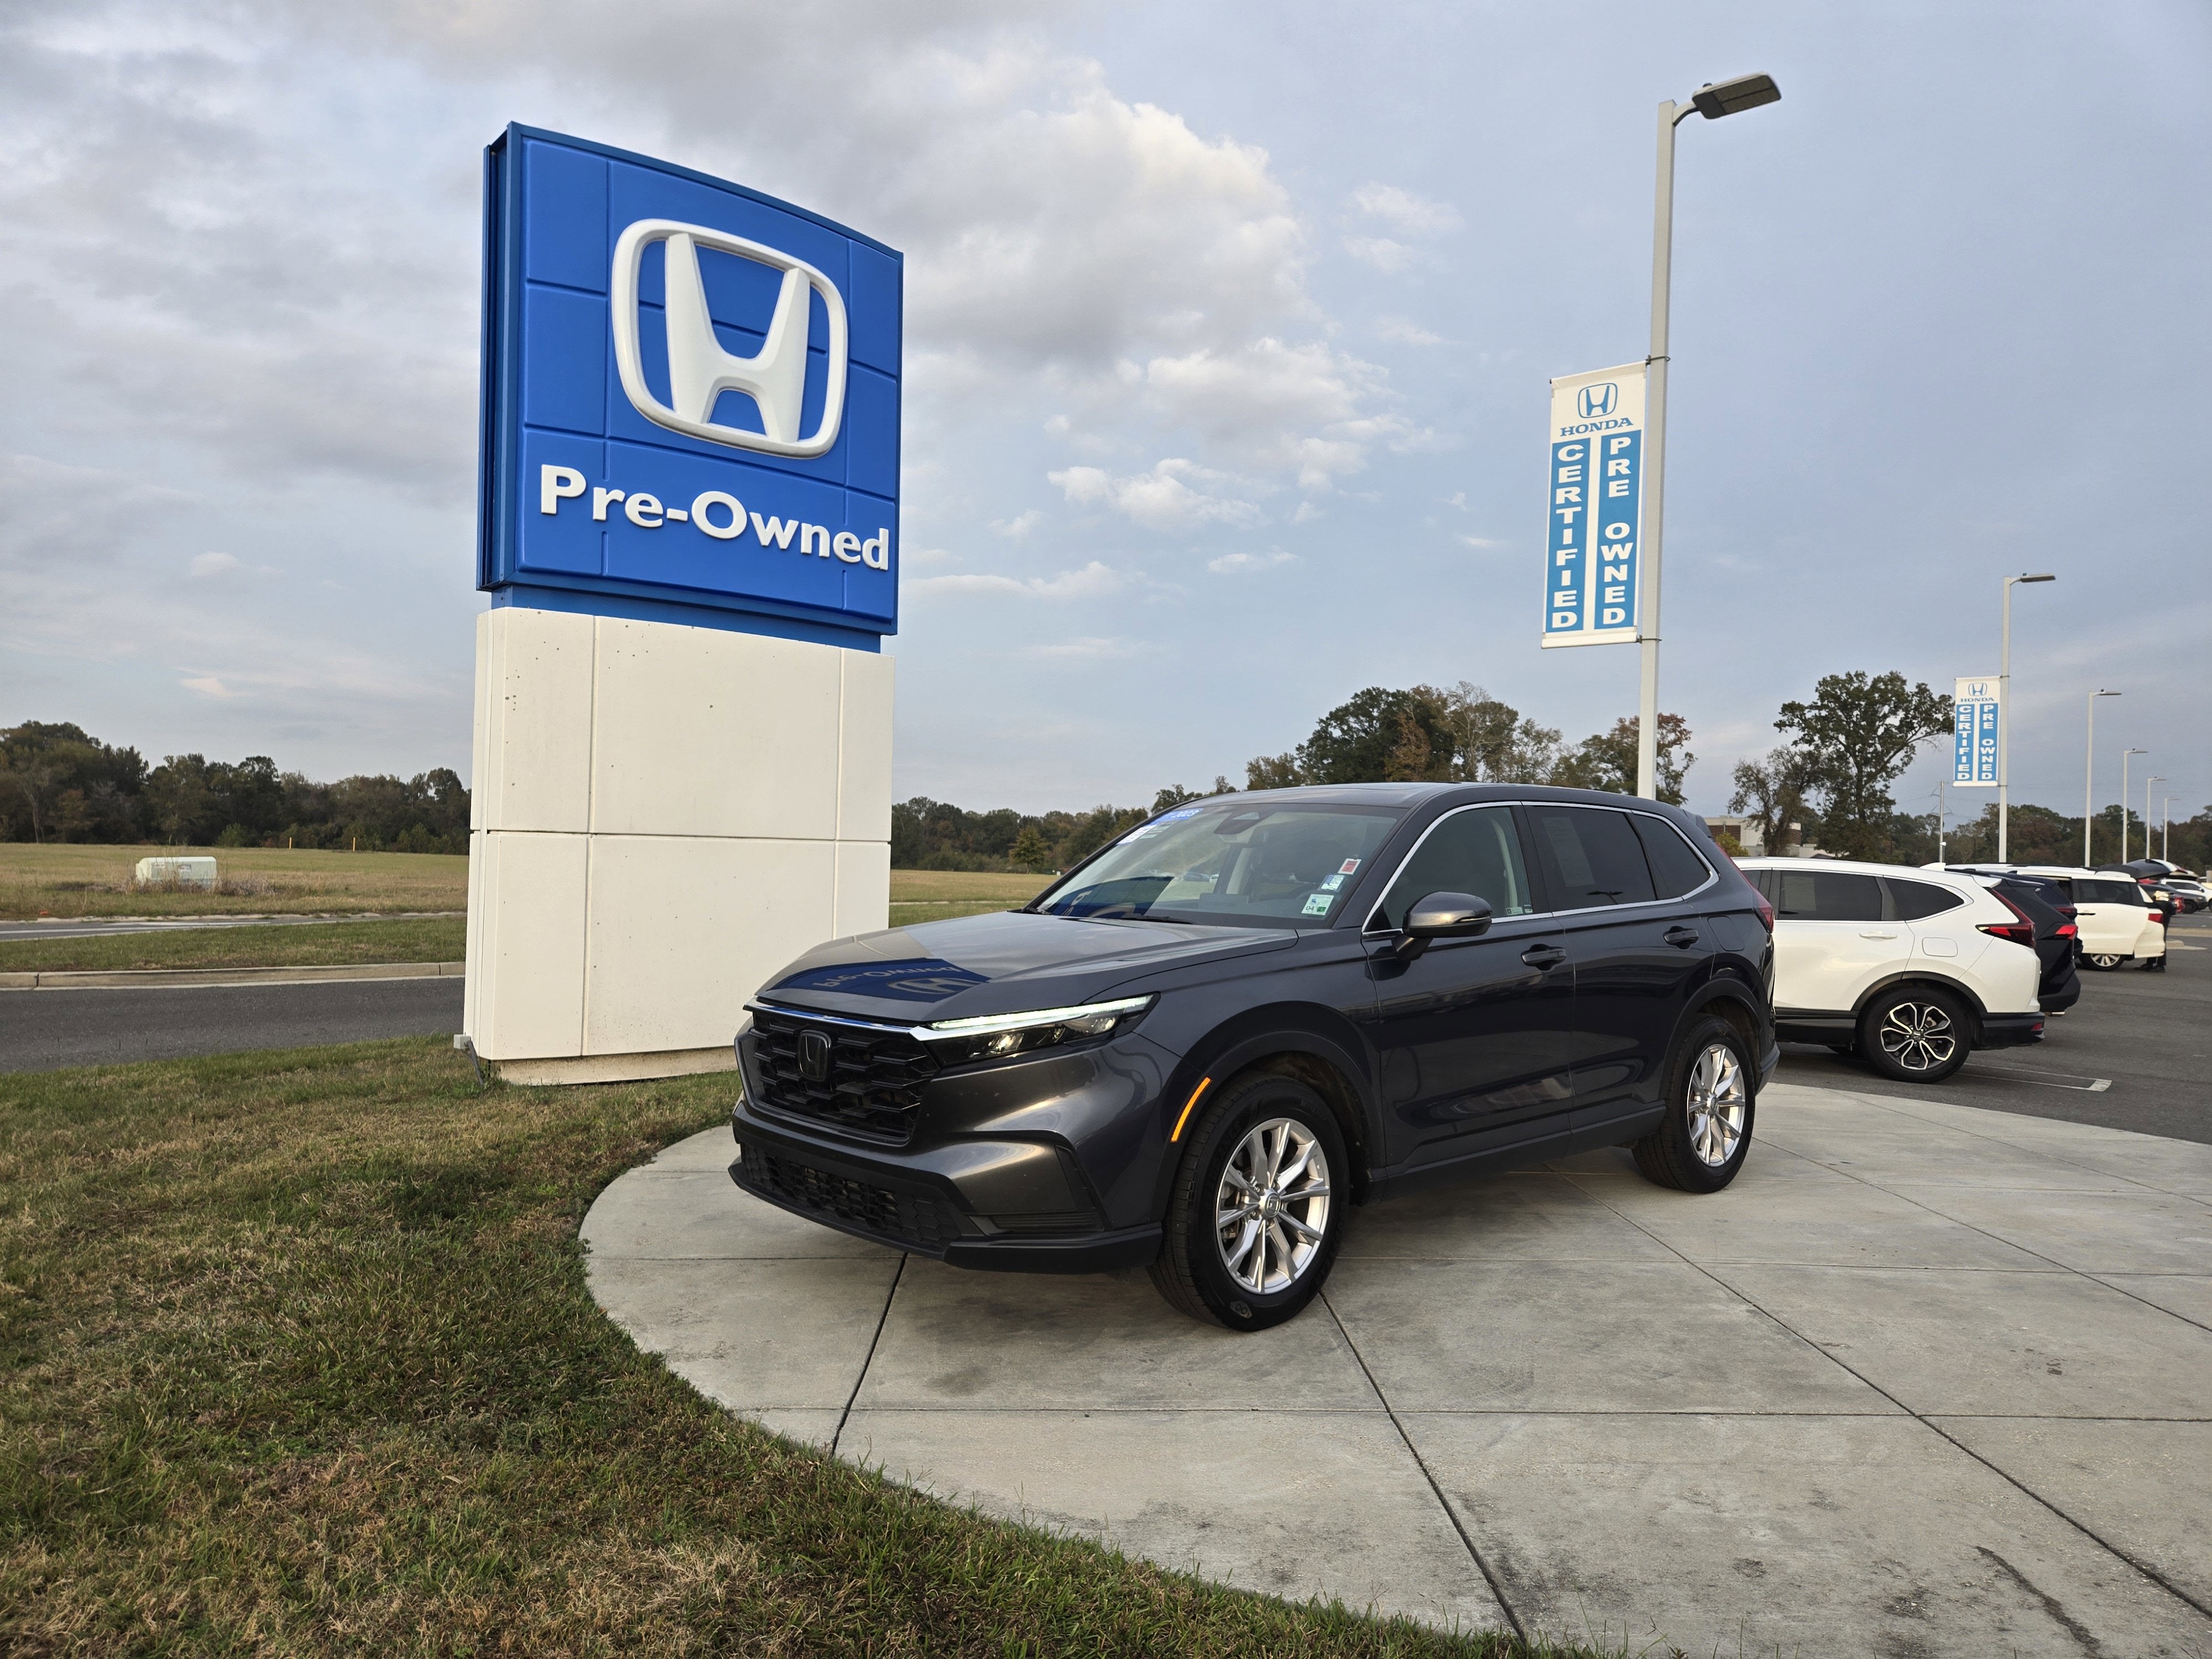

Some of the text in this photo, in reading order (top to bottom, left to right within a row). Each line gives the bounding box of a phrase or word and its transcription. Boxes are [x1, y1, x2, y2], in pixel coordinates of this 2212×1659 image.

[1559, 418, 1634, 437] HONDA
[541, 463, 889, 571] Pre-Owned
[1552, 444, 1584, 628] CERTIFIED
[1600, 437, 1634, 625] PRE OWNED
[1957, 706, 1971, 780] CERTIFIED
[1980, 705, 1995, 780] PRE OWNED
